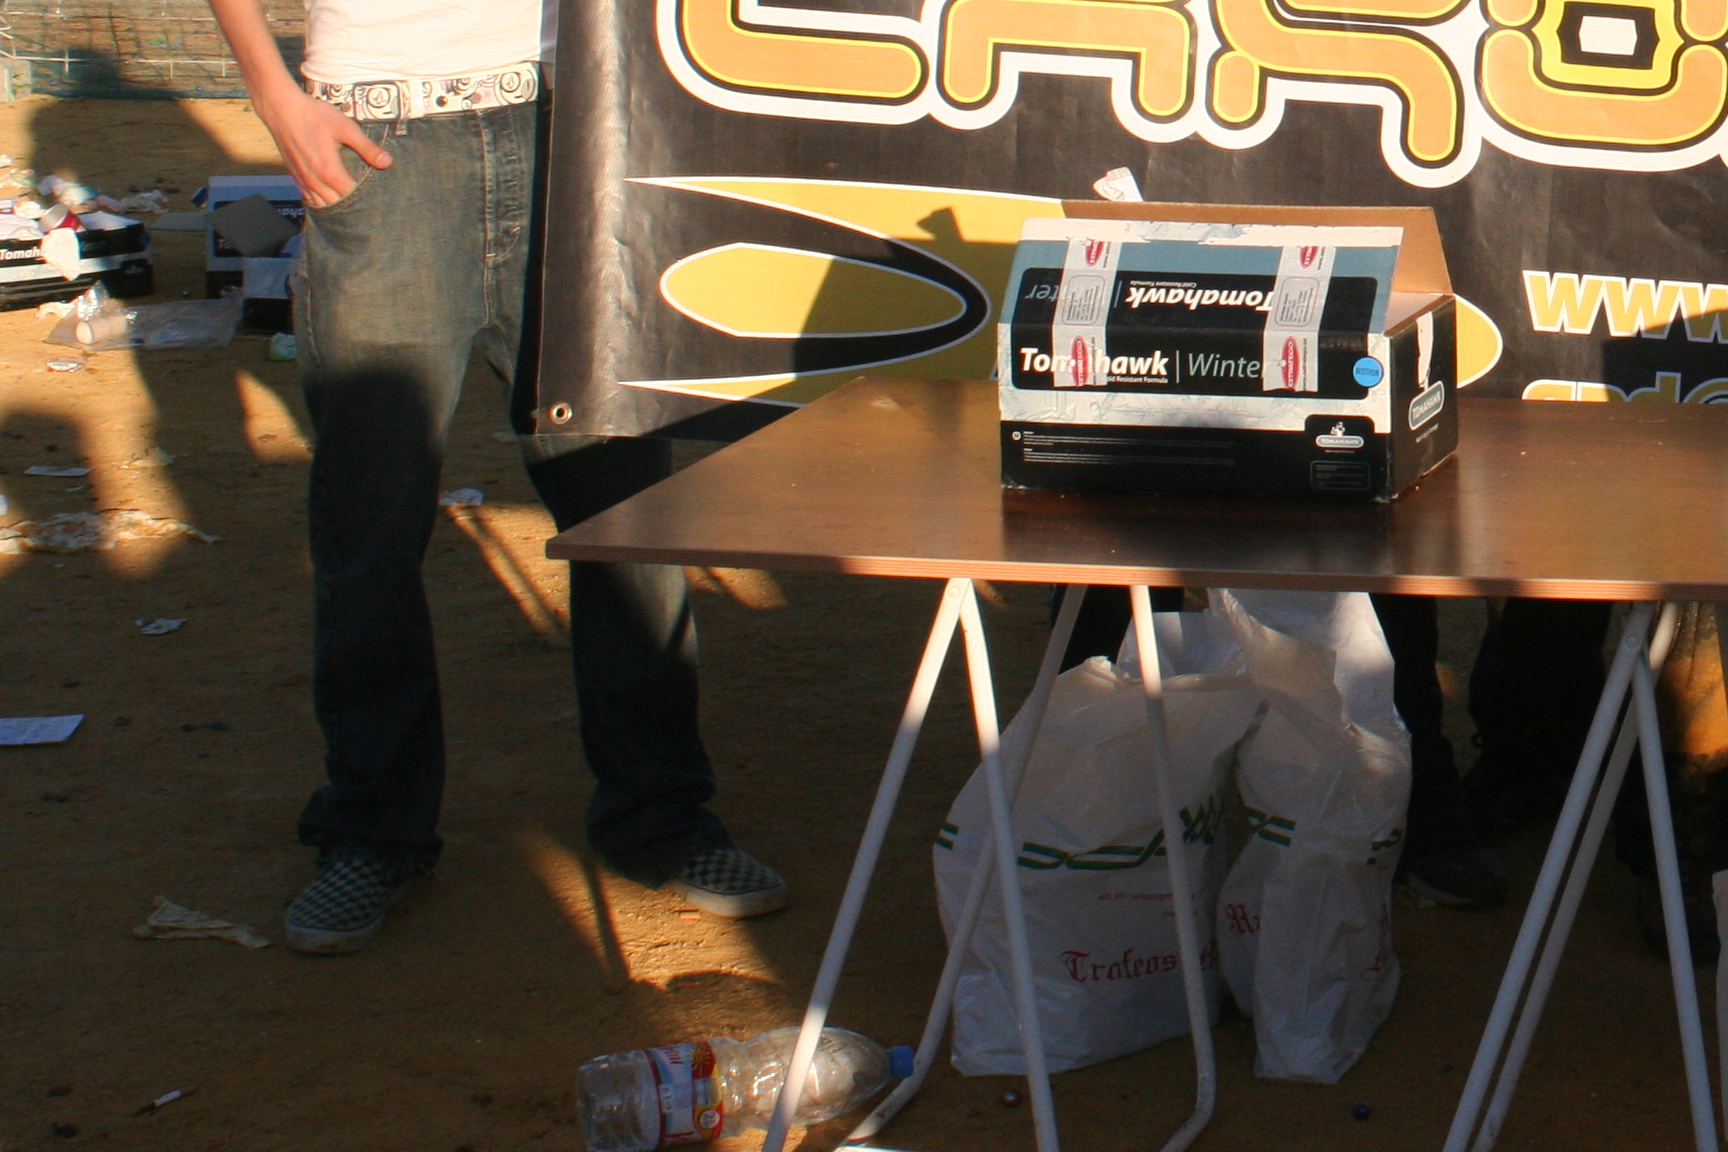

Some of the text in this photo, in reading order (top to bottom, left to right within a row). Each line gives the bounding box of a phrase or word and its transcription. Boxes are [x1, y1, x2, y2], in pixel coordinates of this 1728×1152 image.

[0, 246, 44, 260] Tomah
[1125, 286, 1274, 312] Tomahawk
[1020, 347, 1170, 376] Tomhawk
